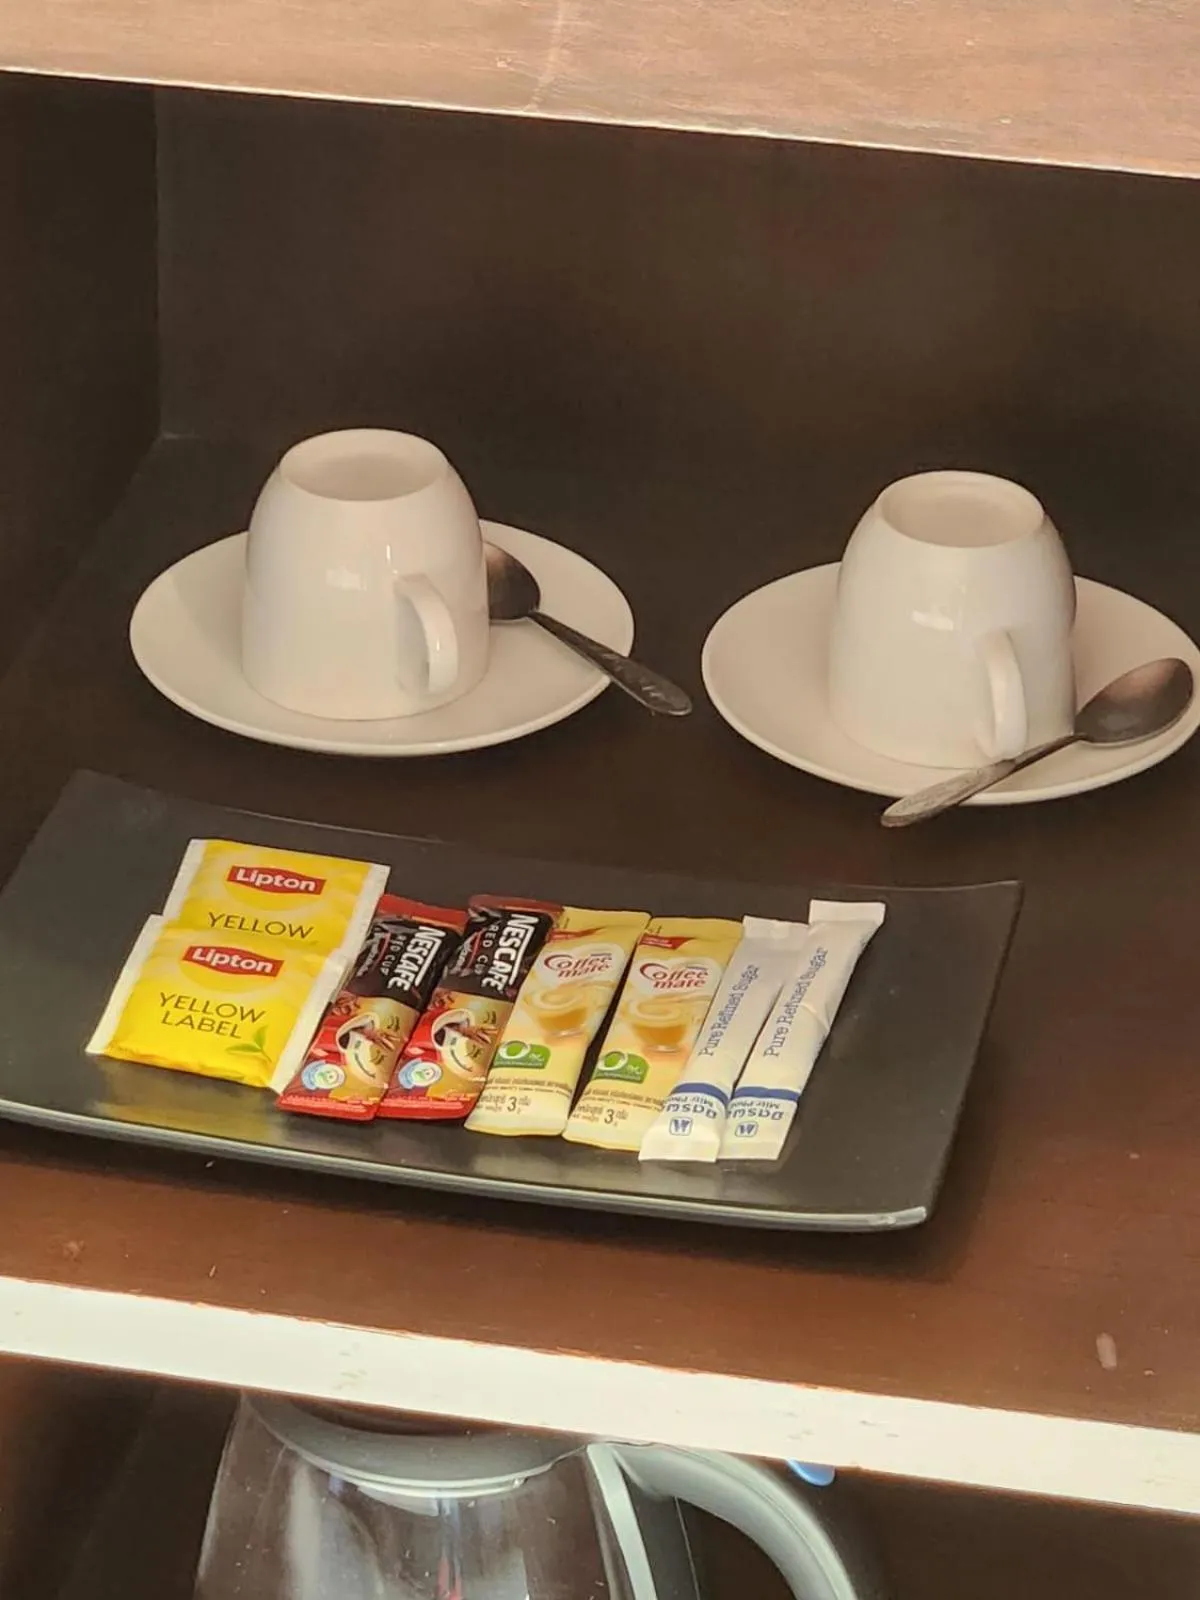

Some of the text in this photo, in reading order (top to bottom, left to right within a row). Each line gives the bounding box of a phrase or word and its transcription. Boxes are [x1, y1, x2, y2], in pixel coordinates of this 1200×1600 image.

[234, 866, 317, 892] Lipton
[207, 911, 314, 939] YELLOW
[482, 923, 500, 947] RED
[190, 947, 274, 974] Lipton
[543, 953, 613, 972] Coffee
[556, 964, 610, 979] mate
[639, 962, 709, 982] Coffee
[653, 977, 706, 990] mate
[159, 991, 266, 1024] YELLOW
[764, 948, 828, 1057] Pure Refined Sugar
[161, 1010, 242, 1039] LABEL
[698, 1027, 723, 1057] Pure
[713, 990, 742, 1029] Refined
[506, 1096, 518, 1113] 3
[603, 1108, 615, 1125] 3
